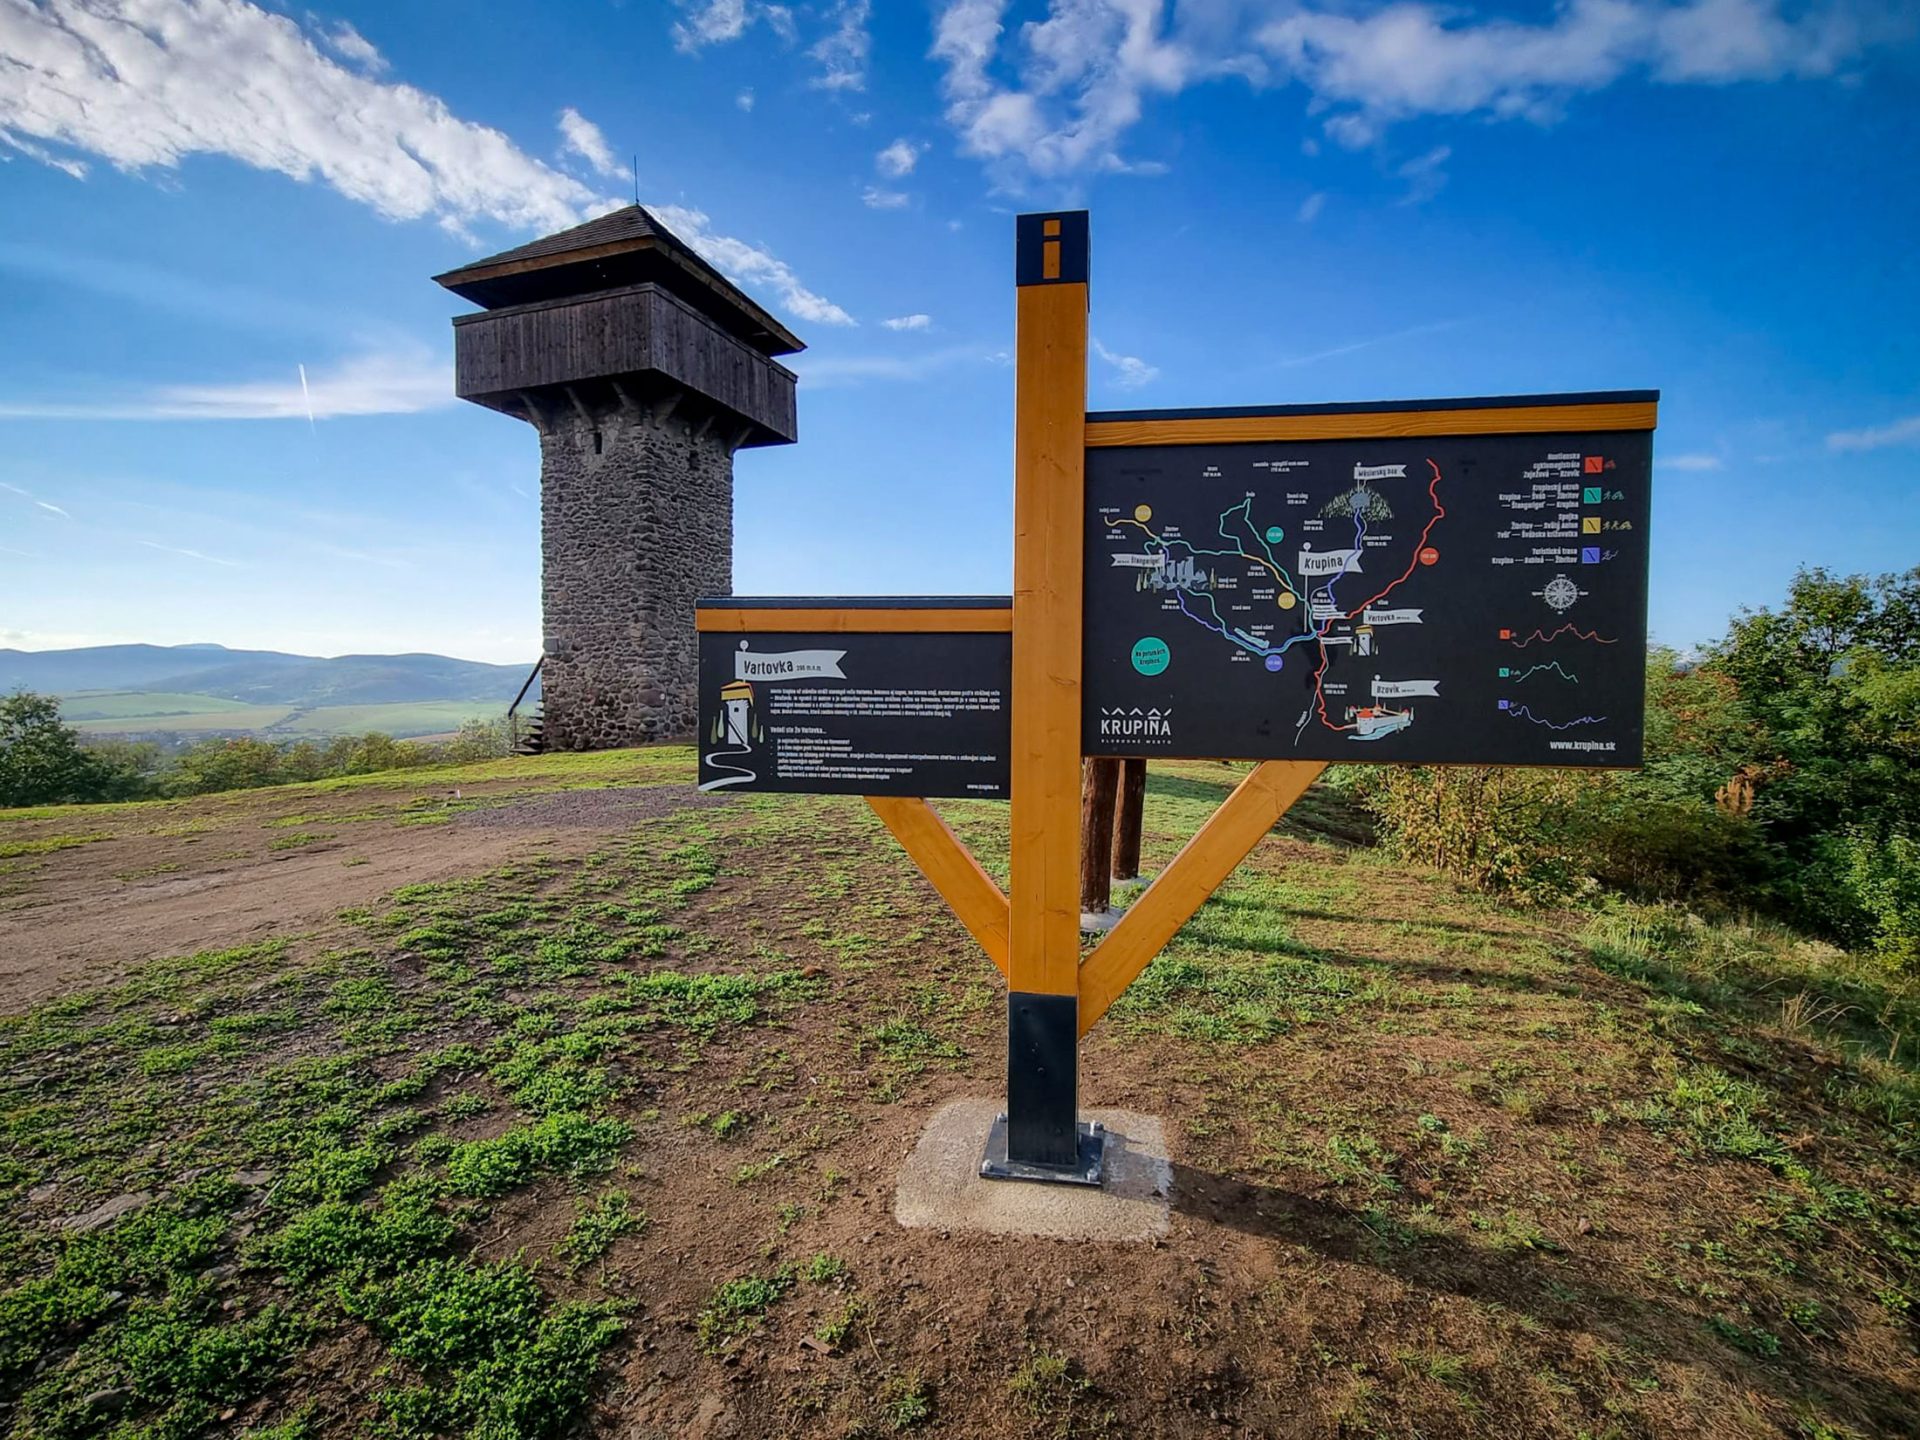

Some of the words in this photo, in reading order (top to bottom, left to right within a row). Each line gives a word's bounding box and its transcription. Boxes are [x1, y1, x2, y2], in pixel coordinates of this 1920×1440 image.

[1304, 556, 1343, 572] Krupina
[744, 660, 794, 675] Vartovka
[1101, 719, 1172, 736] KRUPINA
[1550, 740, 1616, 752] www.krupina.sk
